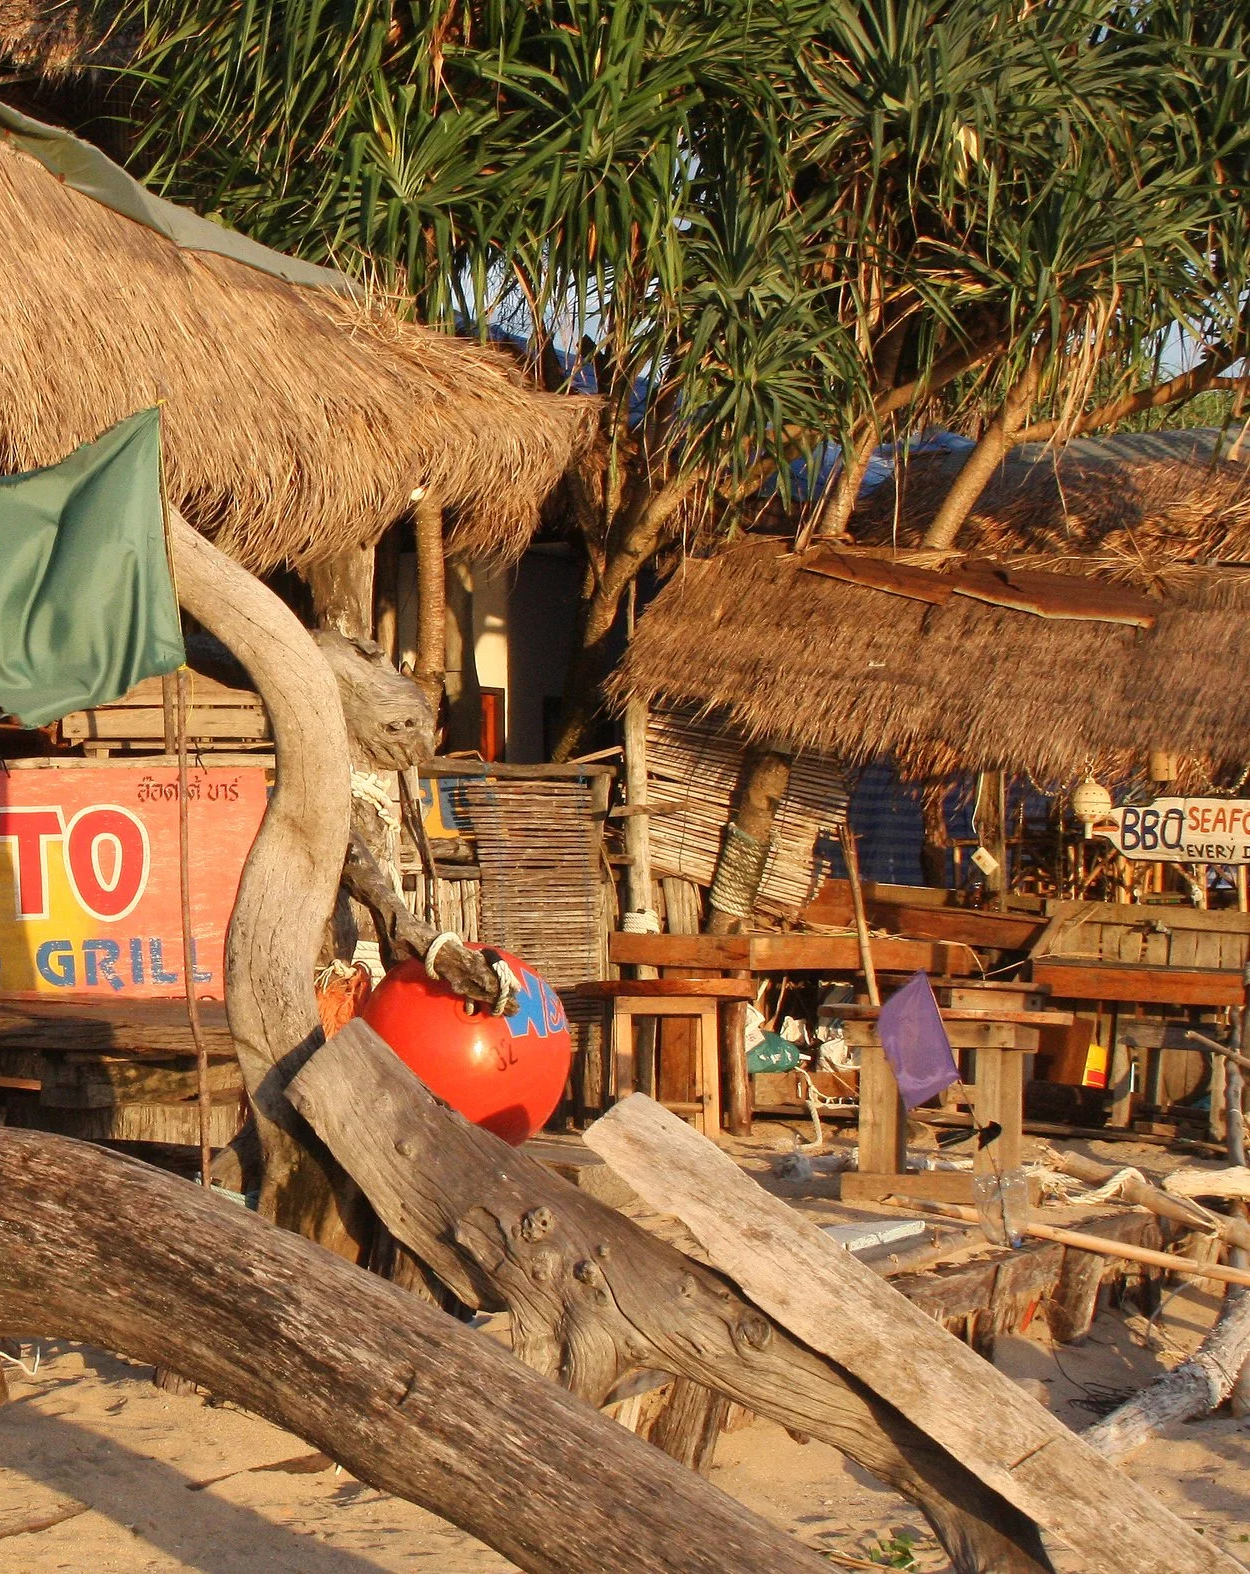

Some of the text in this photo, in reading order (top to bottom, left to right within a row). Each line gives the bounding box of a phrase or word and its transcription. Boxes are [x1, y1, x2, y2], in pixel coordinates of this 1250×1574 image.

[1120, 807, 1185, 852] BBQ
[1187, 843, 1236, 860] EVERY
[36, 937, 213, 991] GRILL
